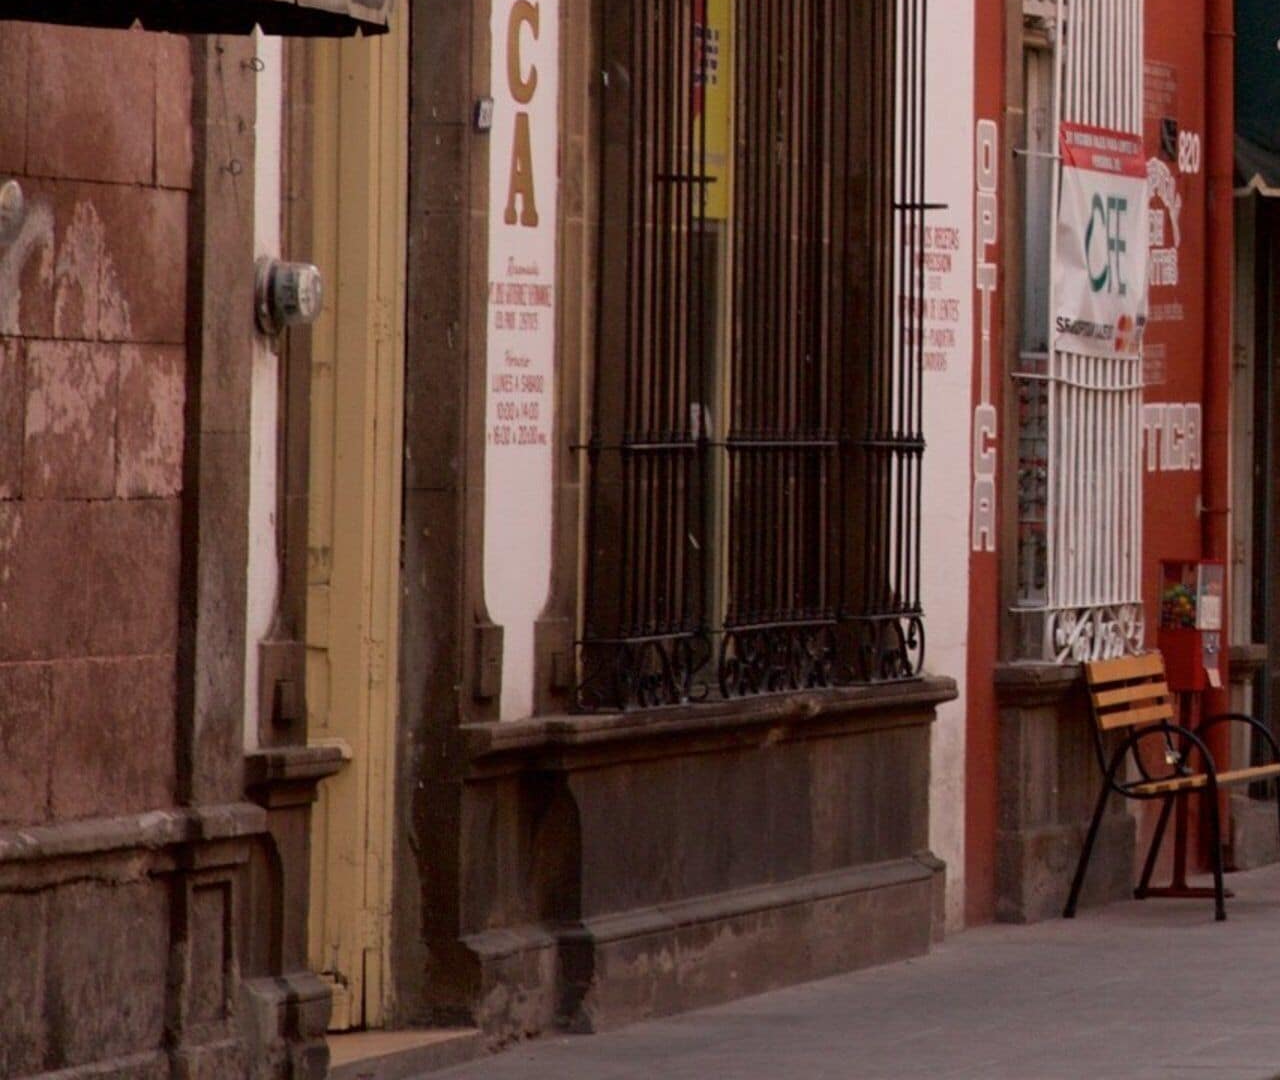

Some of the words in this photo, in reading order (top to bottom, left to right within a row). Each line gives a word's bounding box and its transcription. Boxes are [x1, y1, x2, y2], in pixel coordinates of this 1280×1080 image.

[1177, 131, 1200, 174] 820
[1084, 192, 1129, 295] CFE
[972, 119, 998, 552] OPTICA
[1143, 402, 1202, 472] TICA
